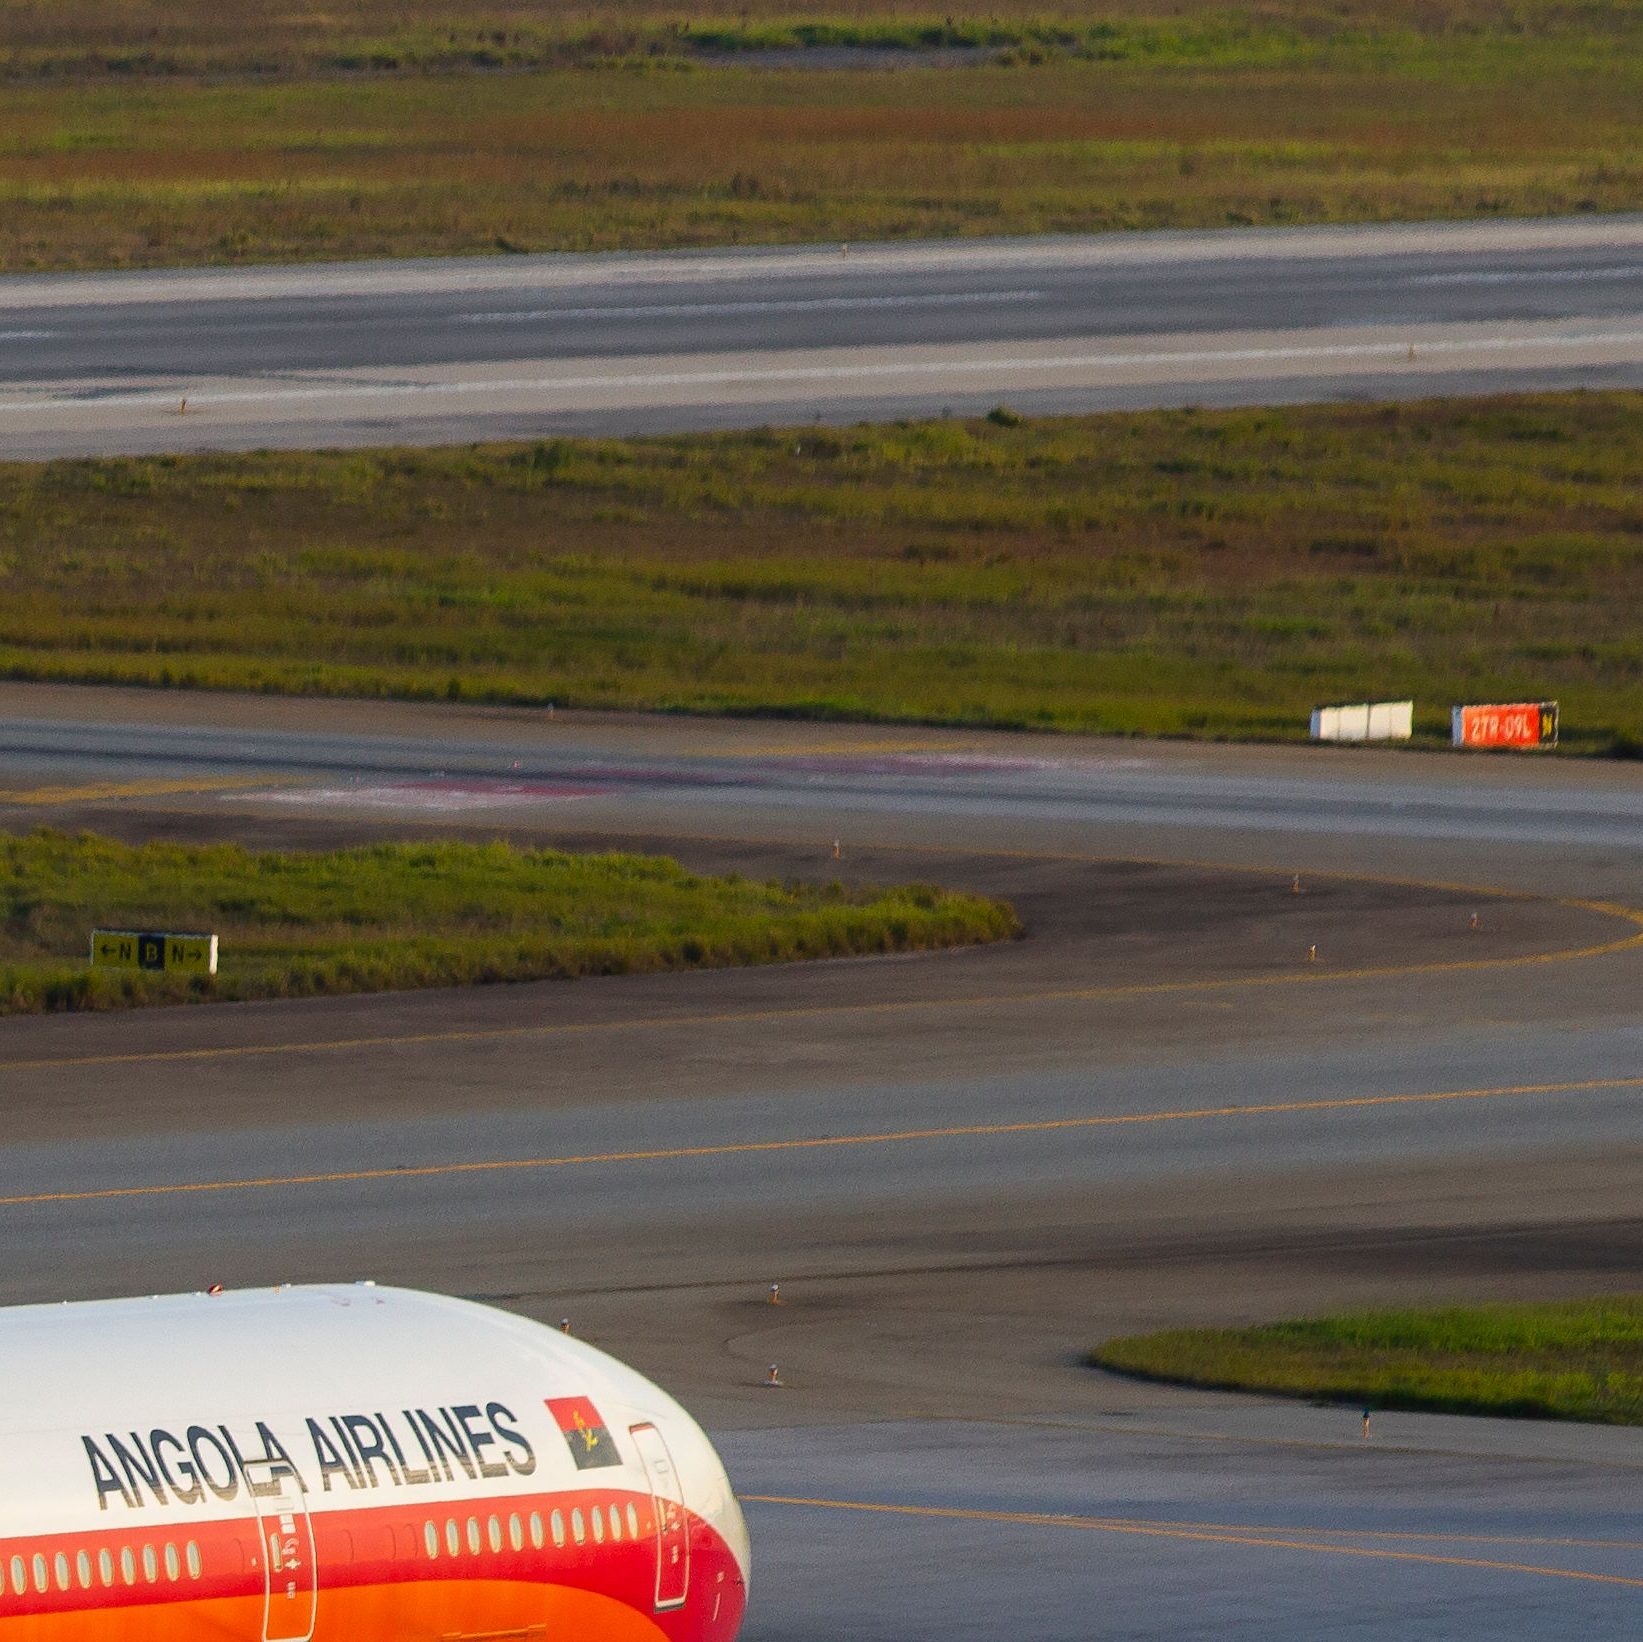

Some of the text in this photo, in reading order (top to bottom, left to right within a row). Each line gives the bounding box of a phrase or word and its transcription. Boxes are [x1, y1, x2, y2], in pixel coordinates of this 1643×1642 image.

[120, 944, 131, 961] N
[172, 944, 185, 963] N
[81, 1402, 538, 1511] ANGOLA AIRLINES
